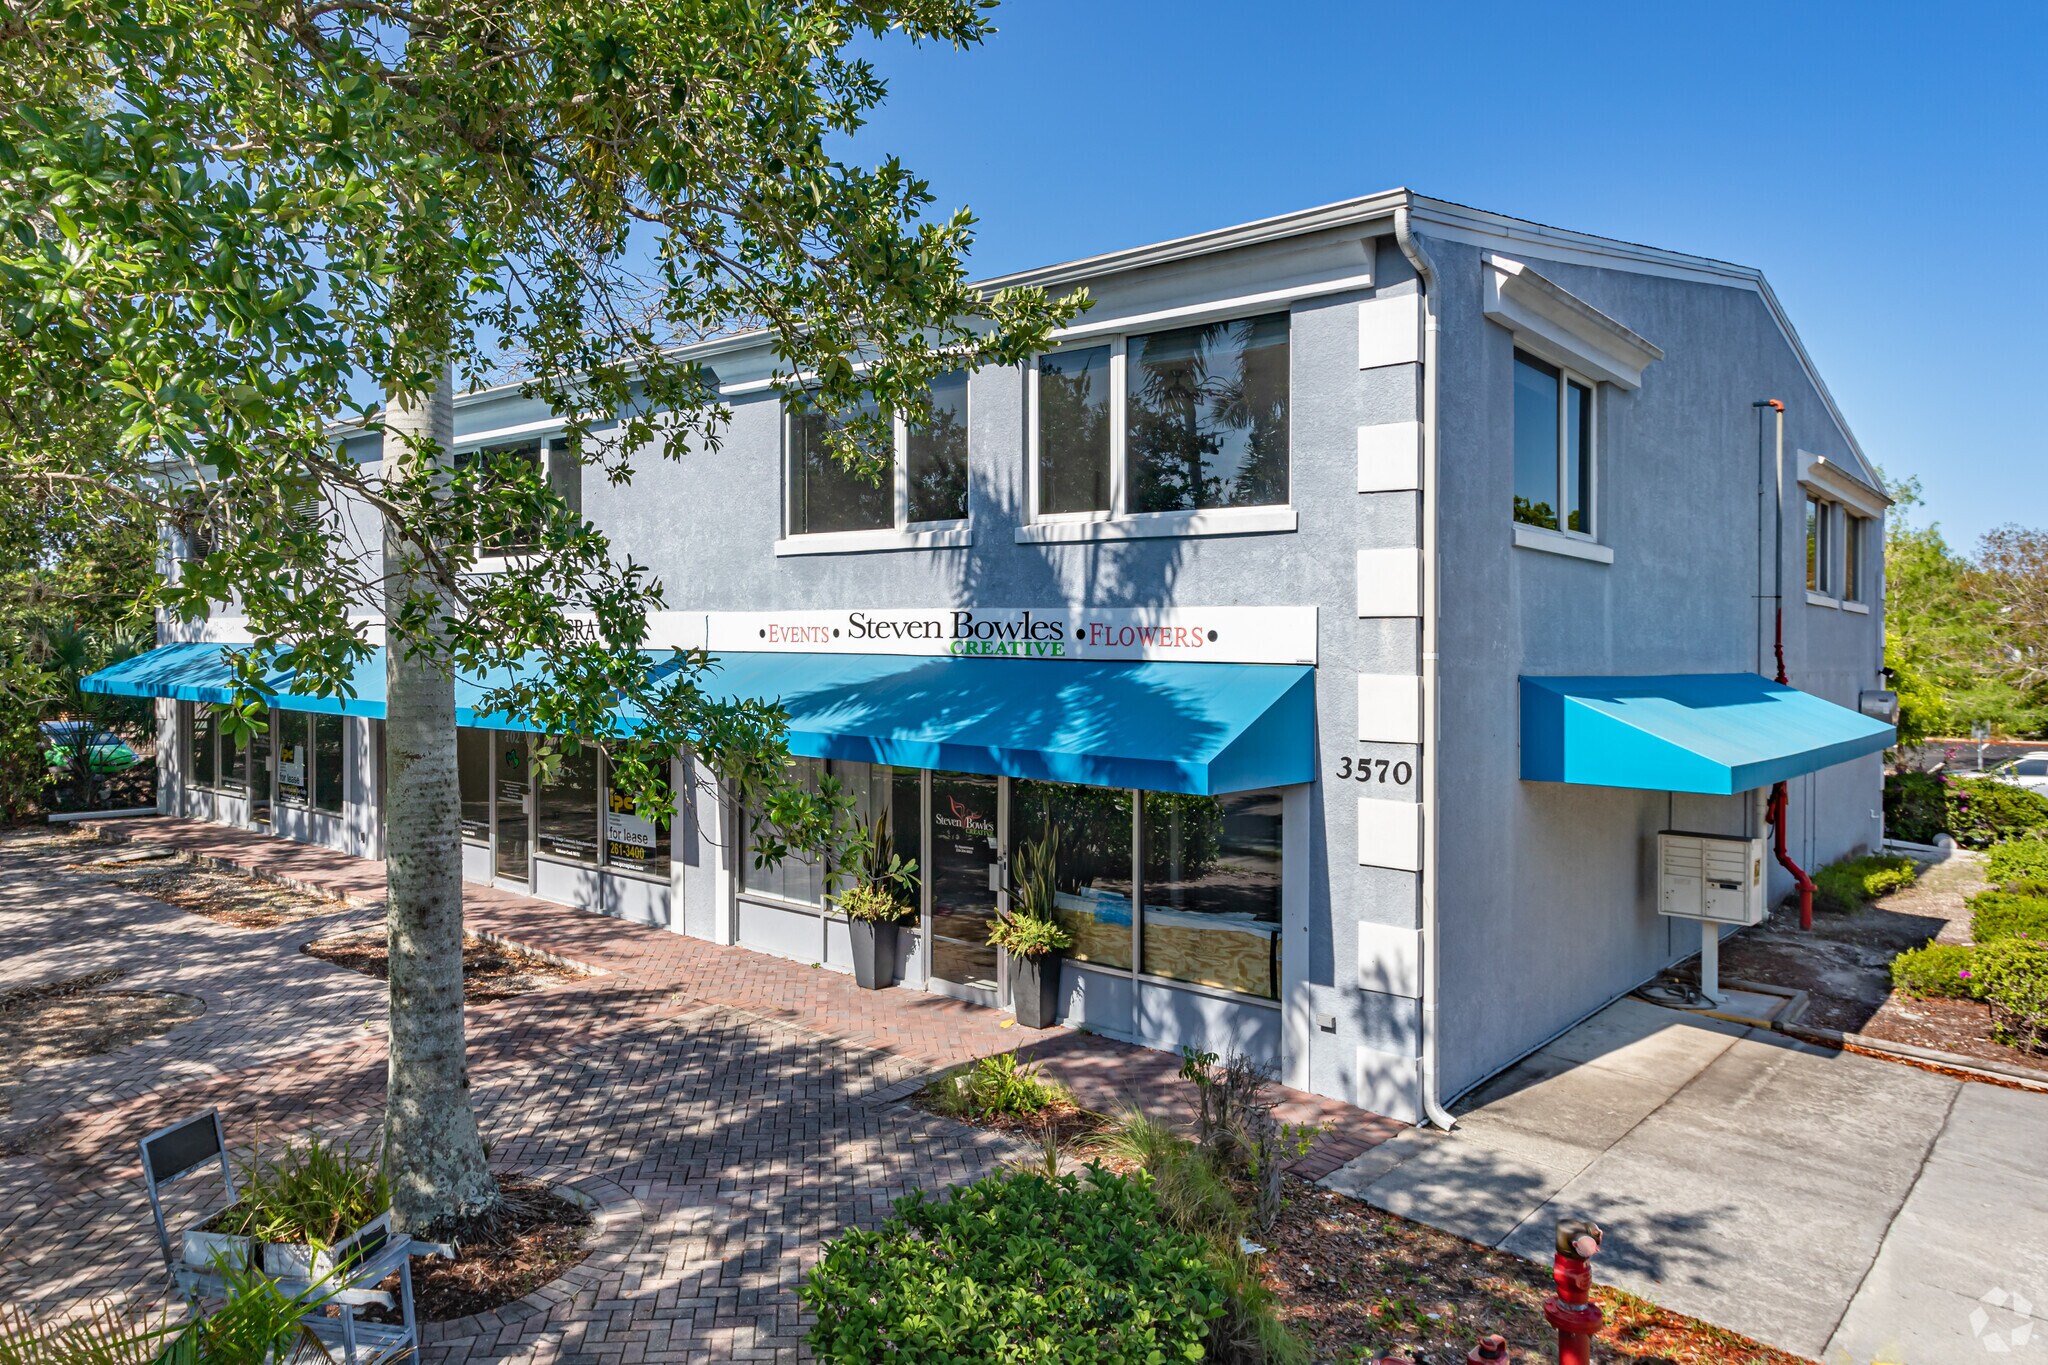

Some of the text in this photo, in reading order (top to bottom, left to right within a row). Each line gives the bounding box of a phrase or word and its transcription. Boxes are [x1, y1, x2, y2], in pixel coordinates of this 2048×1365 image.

[768, 610, 1204, 648] EVENTS Steven Bowles FLOWERS
[949, 640, 1066, 657] CREATIVE
[1336, 756, 1412, 786] 3570
[936, 813, 994, 831] Steven Bowles
[609, 826, 649, 845] for lease
[610, 842, 645, 859] 261-3400
